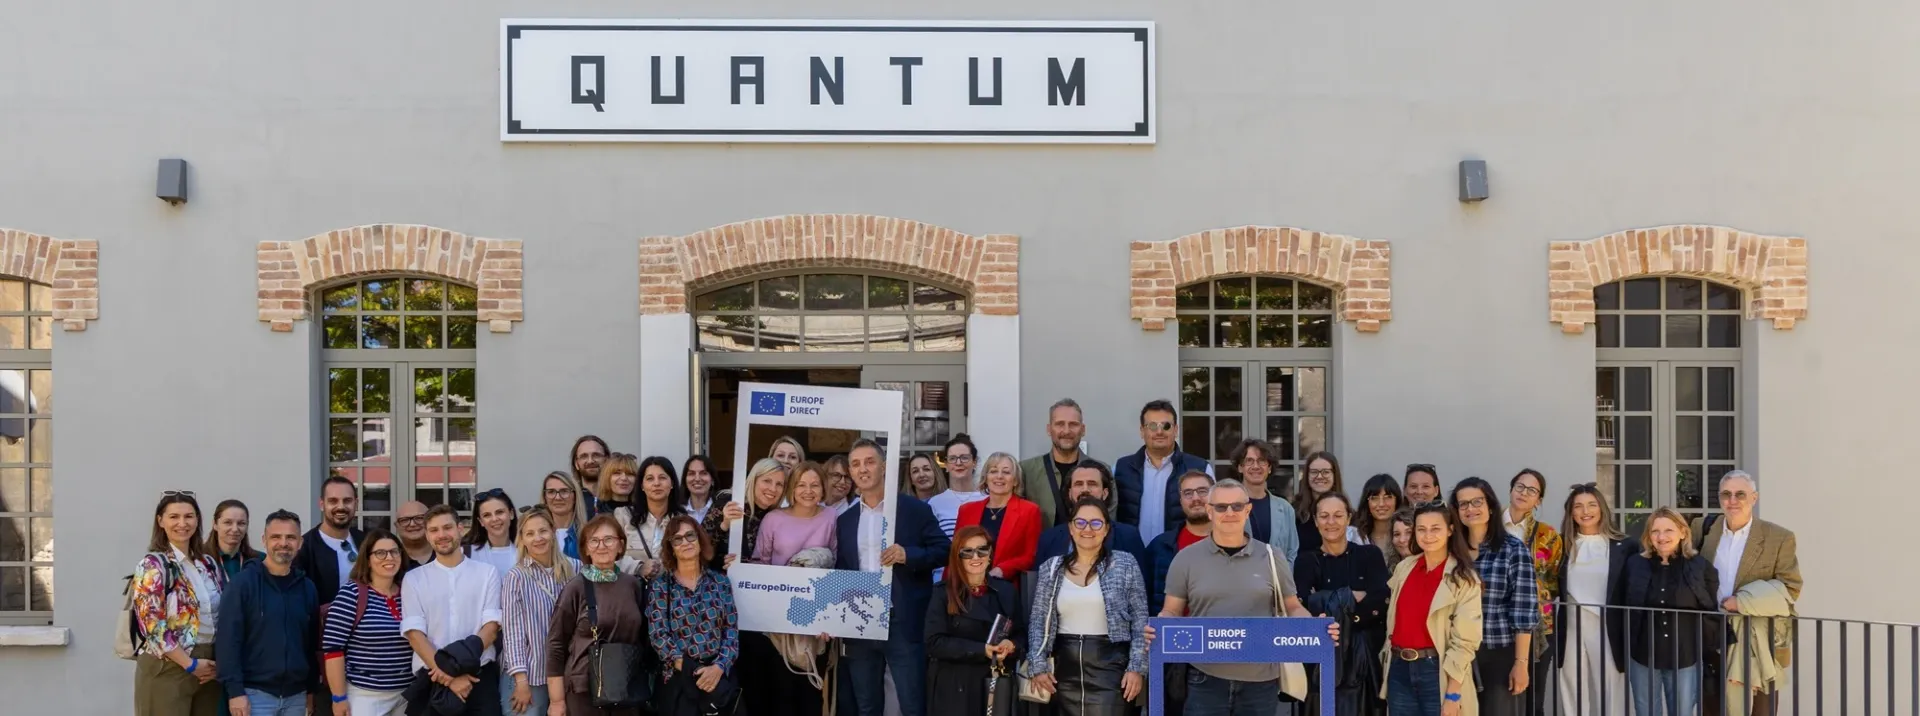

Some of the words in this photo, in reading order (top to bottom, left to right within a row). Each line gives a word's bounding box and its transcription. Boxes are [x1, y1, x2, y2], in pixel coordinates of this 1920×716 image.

[571, 54, 1086, 113] QUANTUM
[790, 396, 825, 405] EUROPE
[789, 406, 821, 416] DIRECT
[738, 581, 811, 594] #EuropeDirect
[1208, 629, 1247, 638] EUROPE
[1208, 641, 1243, 650] DIRECT
[1273, 636, 1321, 646] CROATIA
